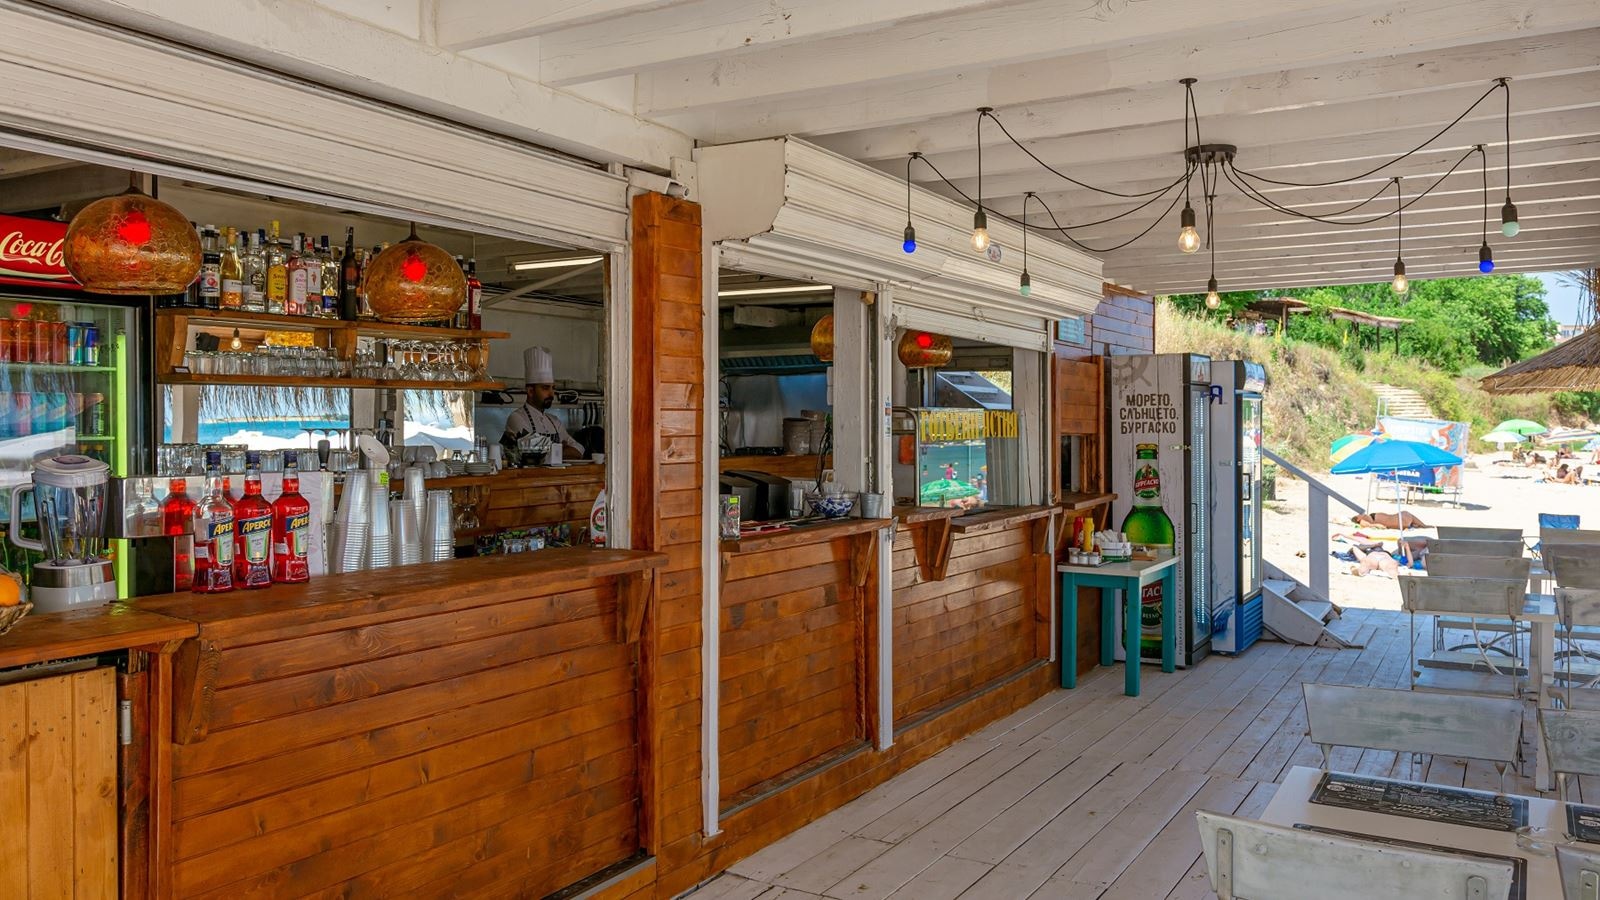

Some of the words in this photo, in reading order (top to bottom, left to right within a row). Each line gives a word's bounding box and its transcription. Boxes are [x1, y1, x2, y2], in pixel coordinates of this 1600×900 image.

[0, 231, 65, 267] Coca-C
[1126, 393, 1173, 407] МОРЕТО.
[1120, 407, 1179, 421] СЛЪНЦЕТО.
[1120, 421, 1177, 434] БУРГАСКО
